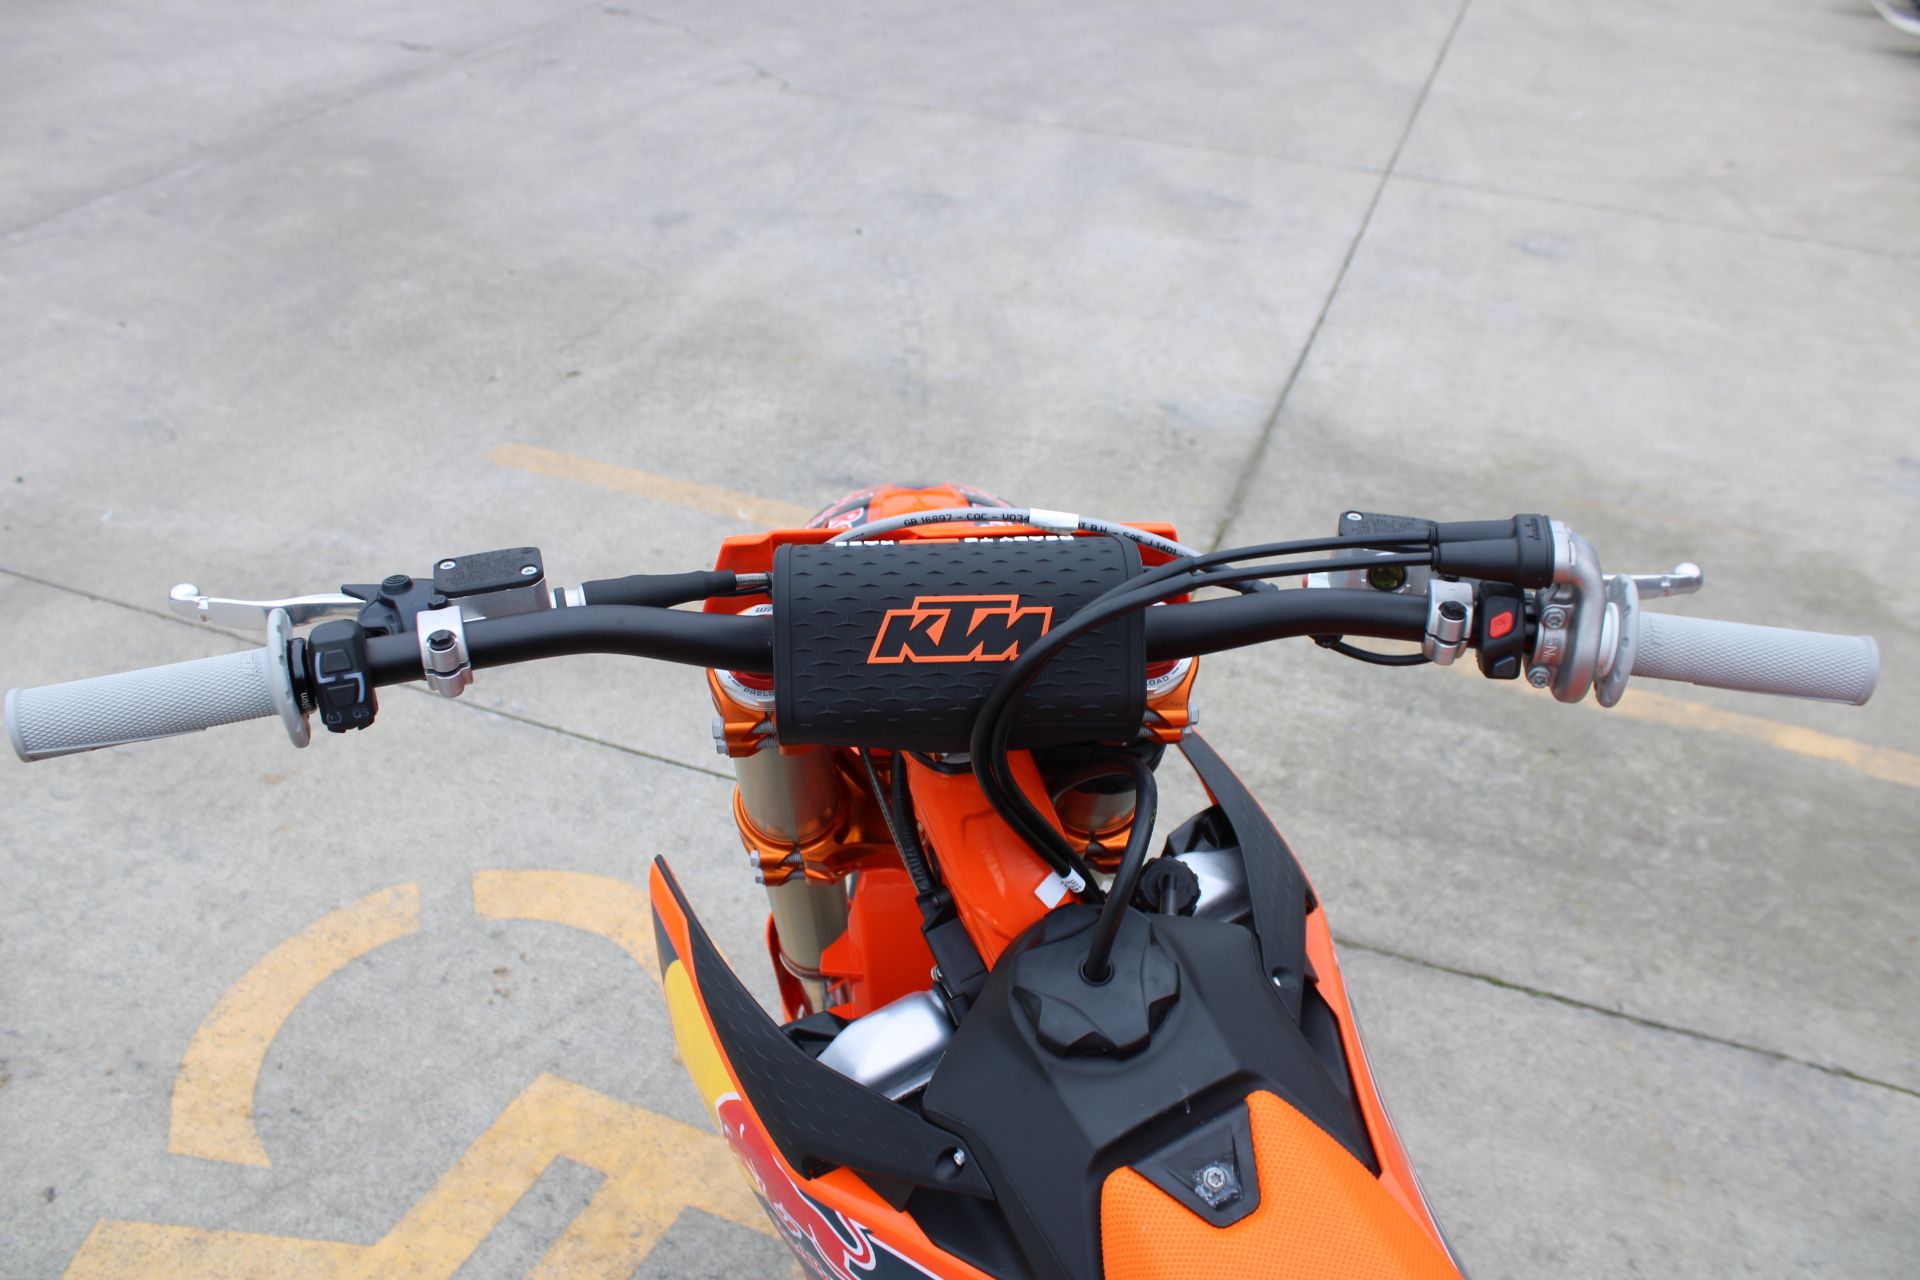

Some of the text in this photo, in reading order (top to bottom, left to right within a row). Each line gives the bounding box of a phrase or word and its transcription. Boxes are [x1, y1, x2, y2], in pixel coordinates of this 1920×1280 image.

[920, 513, 953, 525] 16897
[867, 594, 1054, 664] KTM
[1147, 675, 1170, 686] OAD
[743, 687, 775, 697] PRELO
